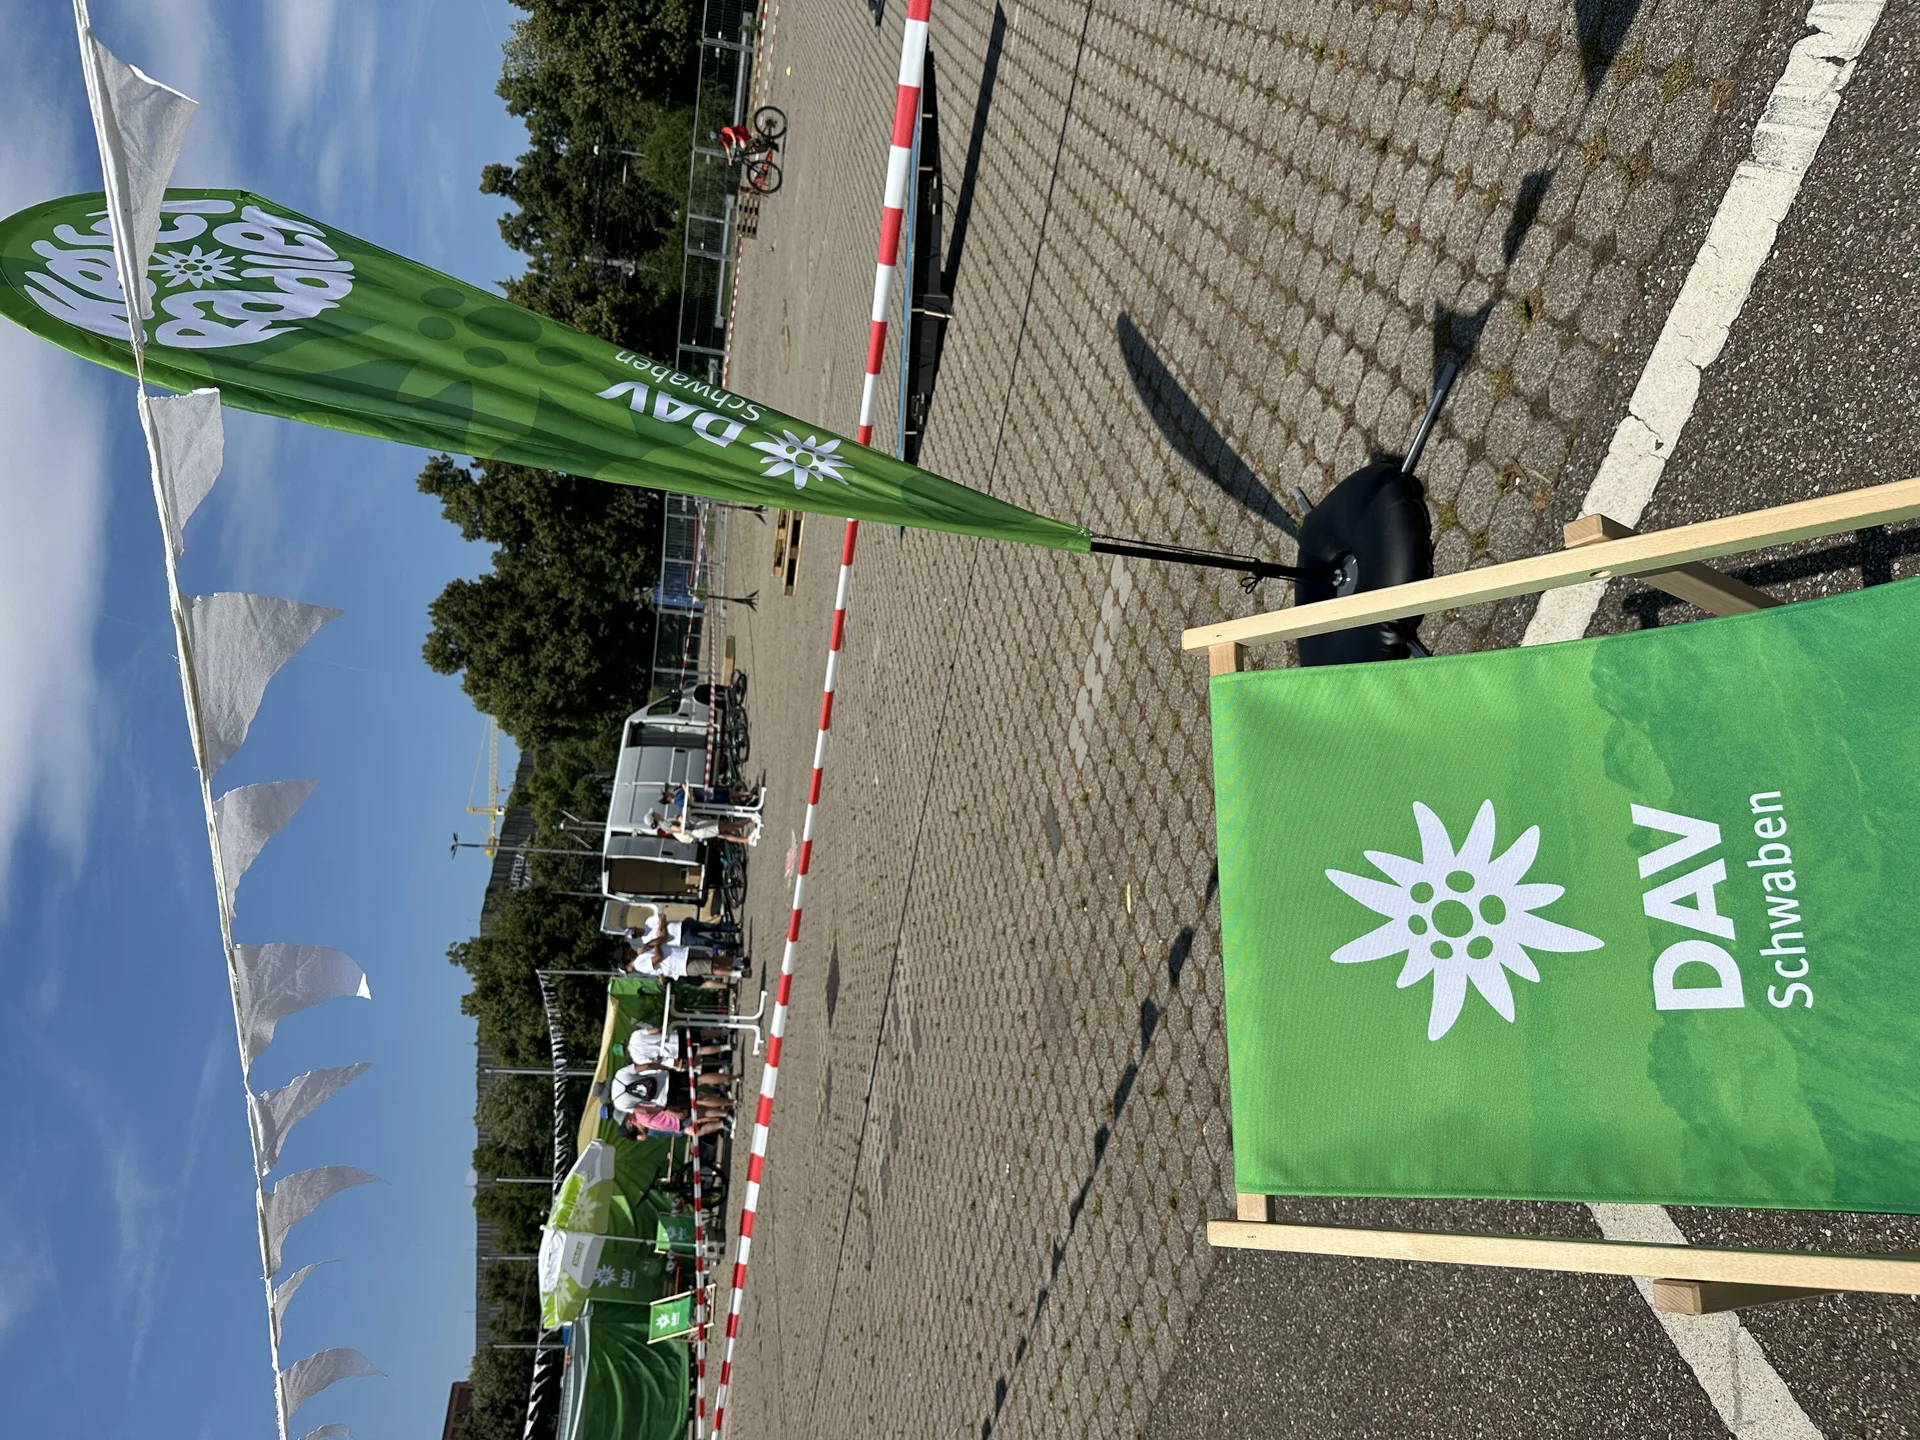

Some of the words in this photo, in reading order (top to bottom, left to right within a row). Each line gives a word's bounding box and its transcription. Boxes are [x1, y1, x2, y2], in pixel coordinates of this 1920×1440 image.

[156, 206, 355, 349] Radler
[595, 381, 747, 447] DAV
[614, 350, 768, 421] Schwaben
[1630, 803, 1745, 1010] DAV
[1746, 790, 1814, 1009] Schwaben
[620, 1268, 631, 1289] DAV
